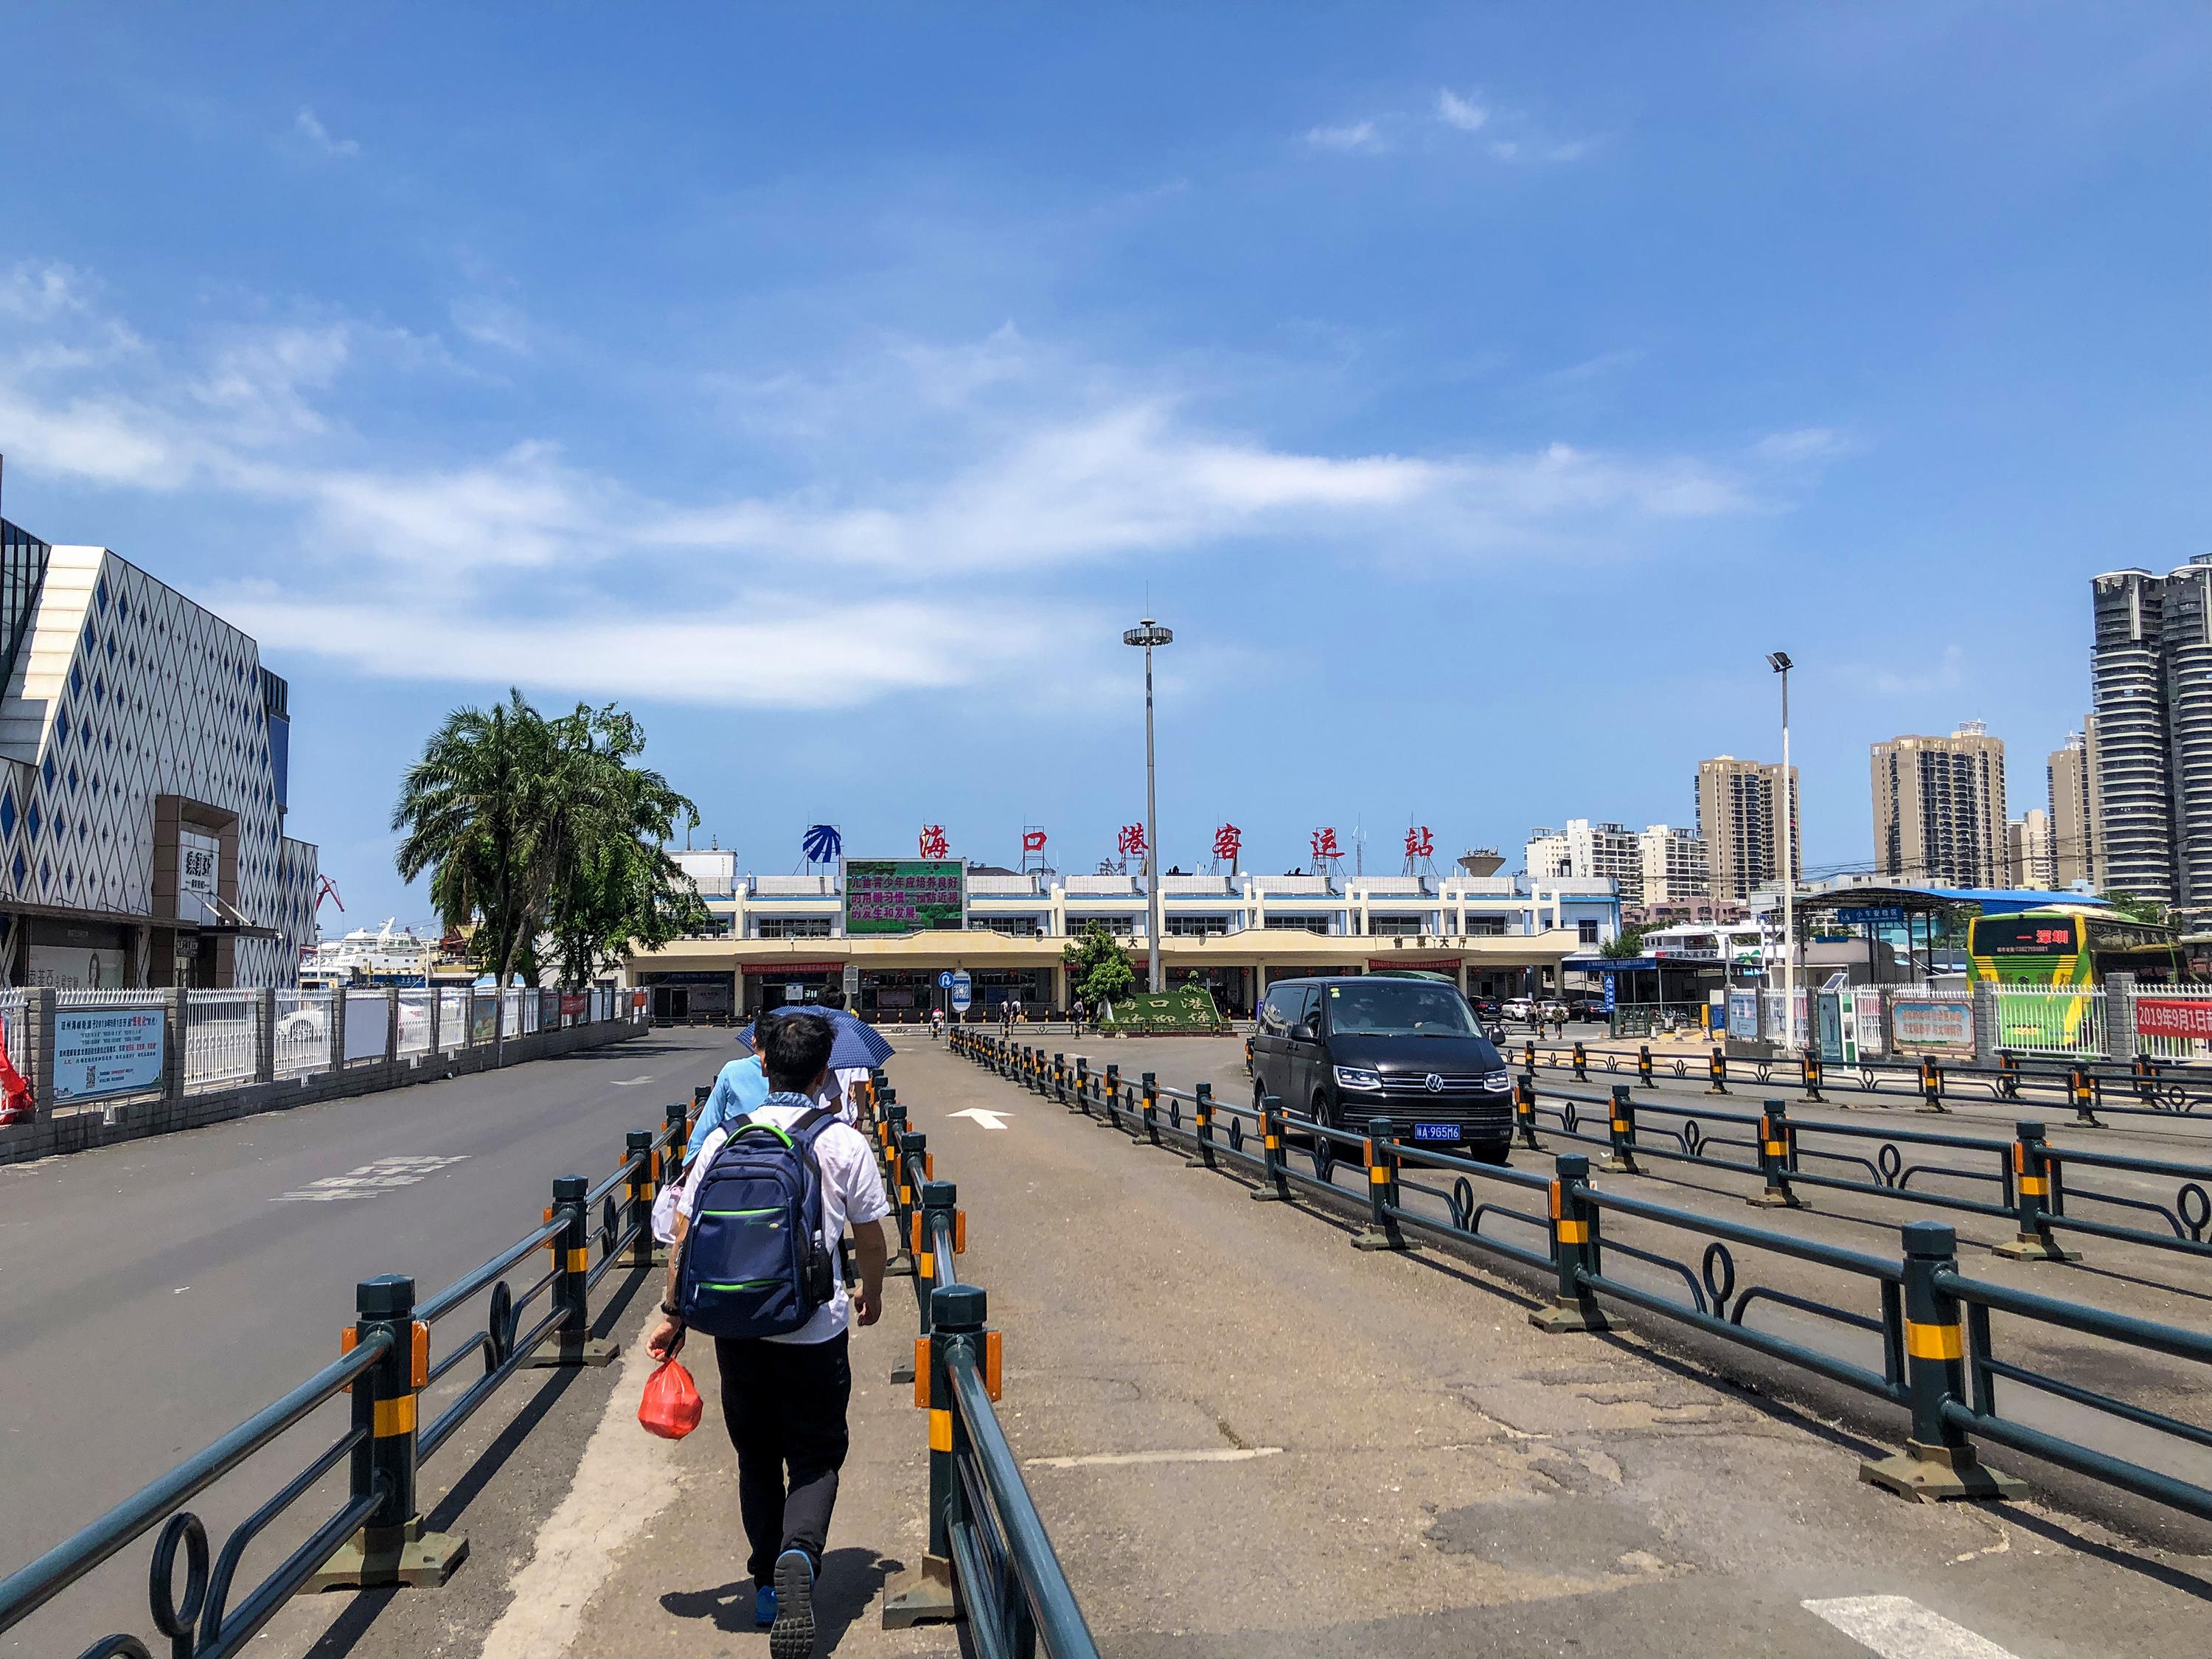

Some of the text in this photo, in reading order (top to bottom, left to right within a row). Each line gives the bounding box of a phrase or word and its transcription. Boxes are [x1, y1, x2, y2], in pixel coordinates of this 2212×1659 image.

[919, 823, 1434, 860] 海口港客运站
[851, 875, 959, 888] 儿童青少年应培养良好
[851, 905, 921, 919] 的发生和发展。
[1114, 997, 1212, 1010] 海口港
